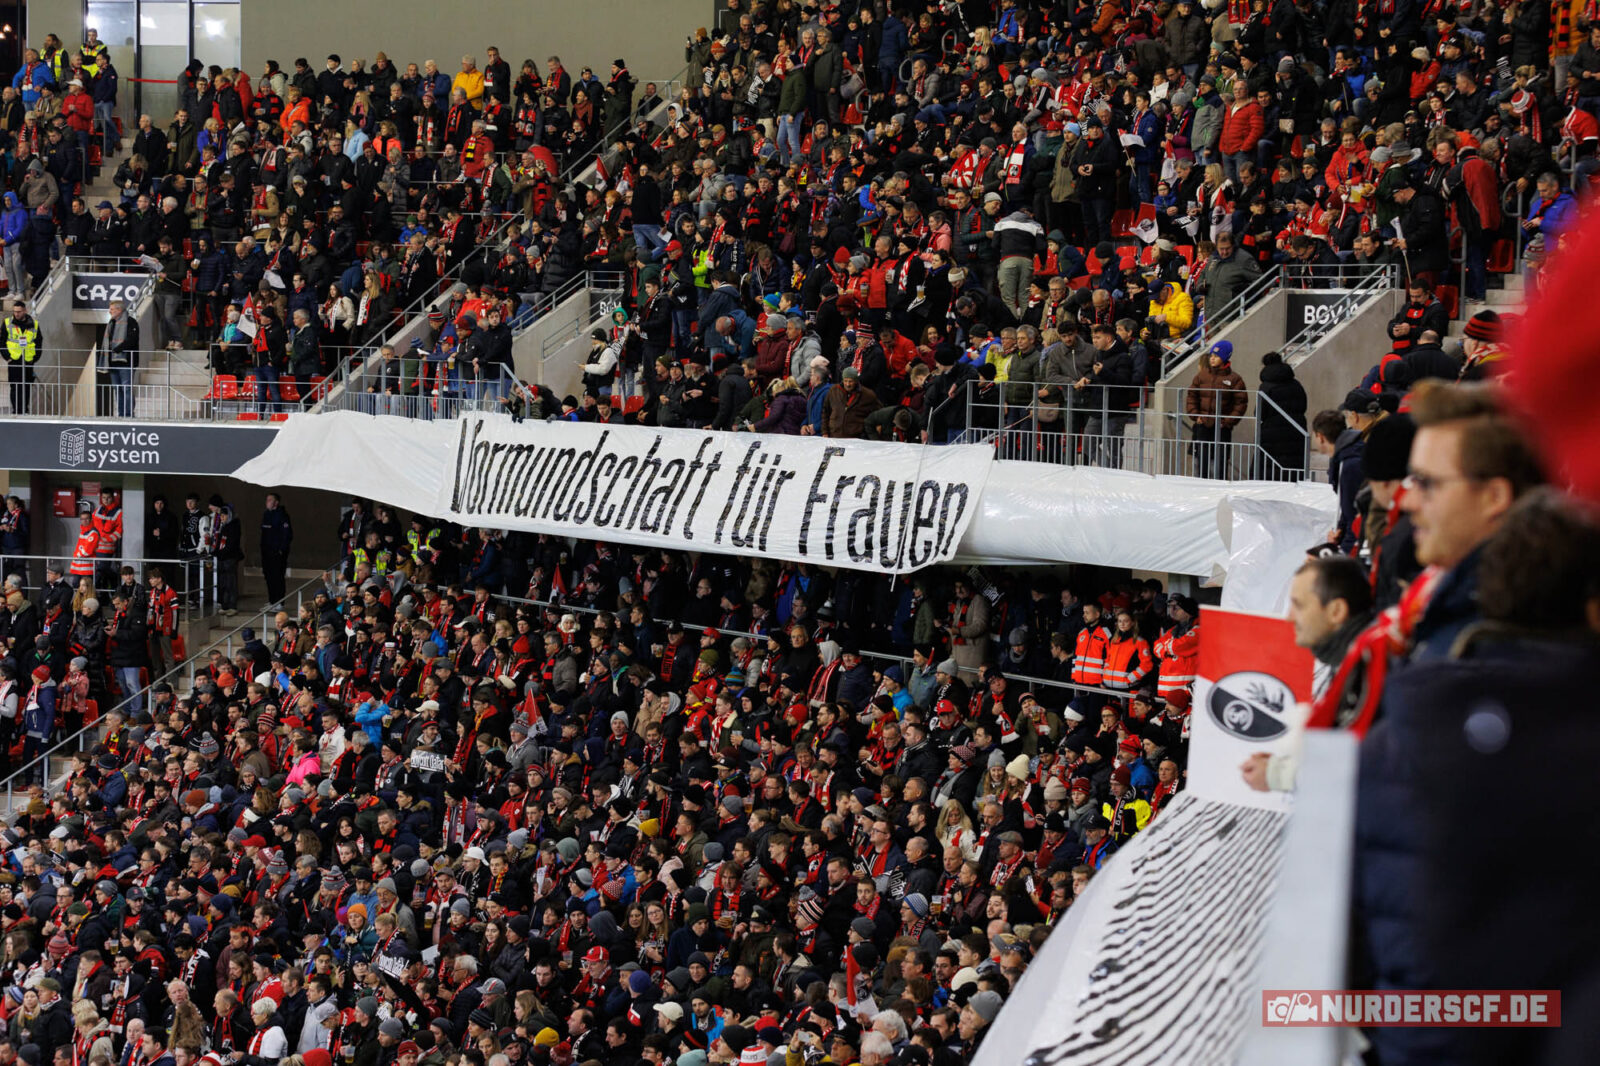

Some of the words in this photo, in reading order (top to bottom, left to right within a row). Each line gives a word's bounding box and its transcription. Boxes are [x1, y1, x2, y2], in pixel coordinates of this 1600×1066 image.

[87, 427, 160, 446] service
[87, 447, 160, 469] system
[450, 418, 723, 540] Vormundschaft
[714, 440, 796, 552] für
[798, 446, 969, 570] Frauen
